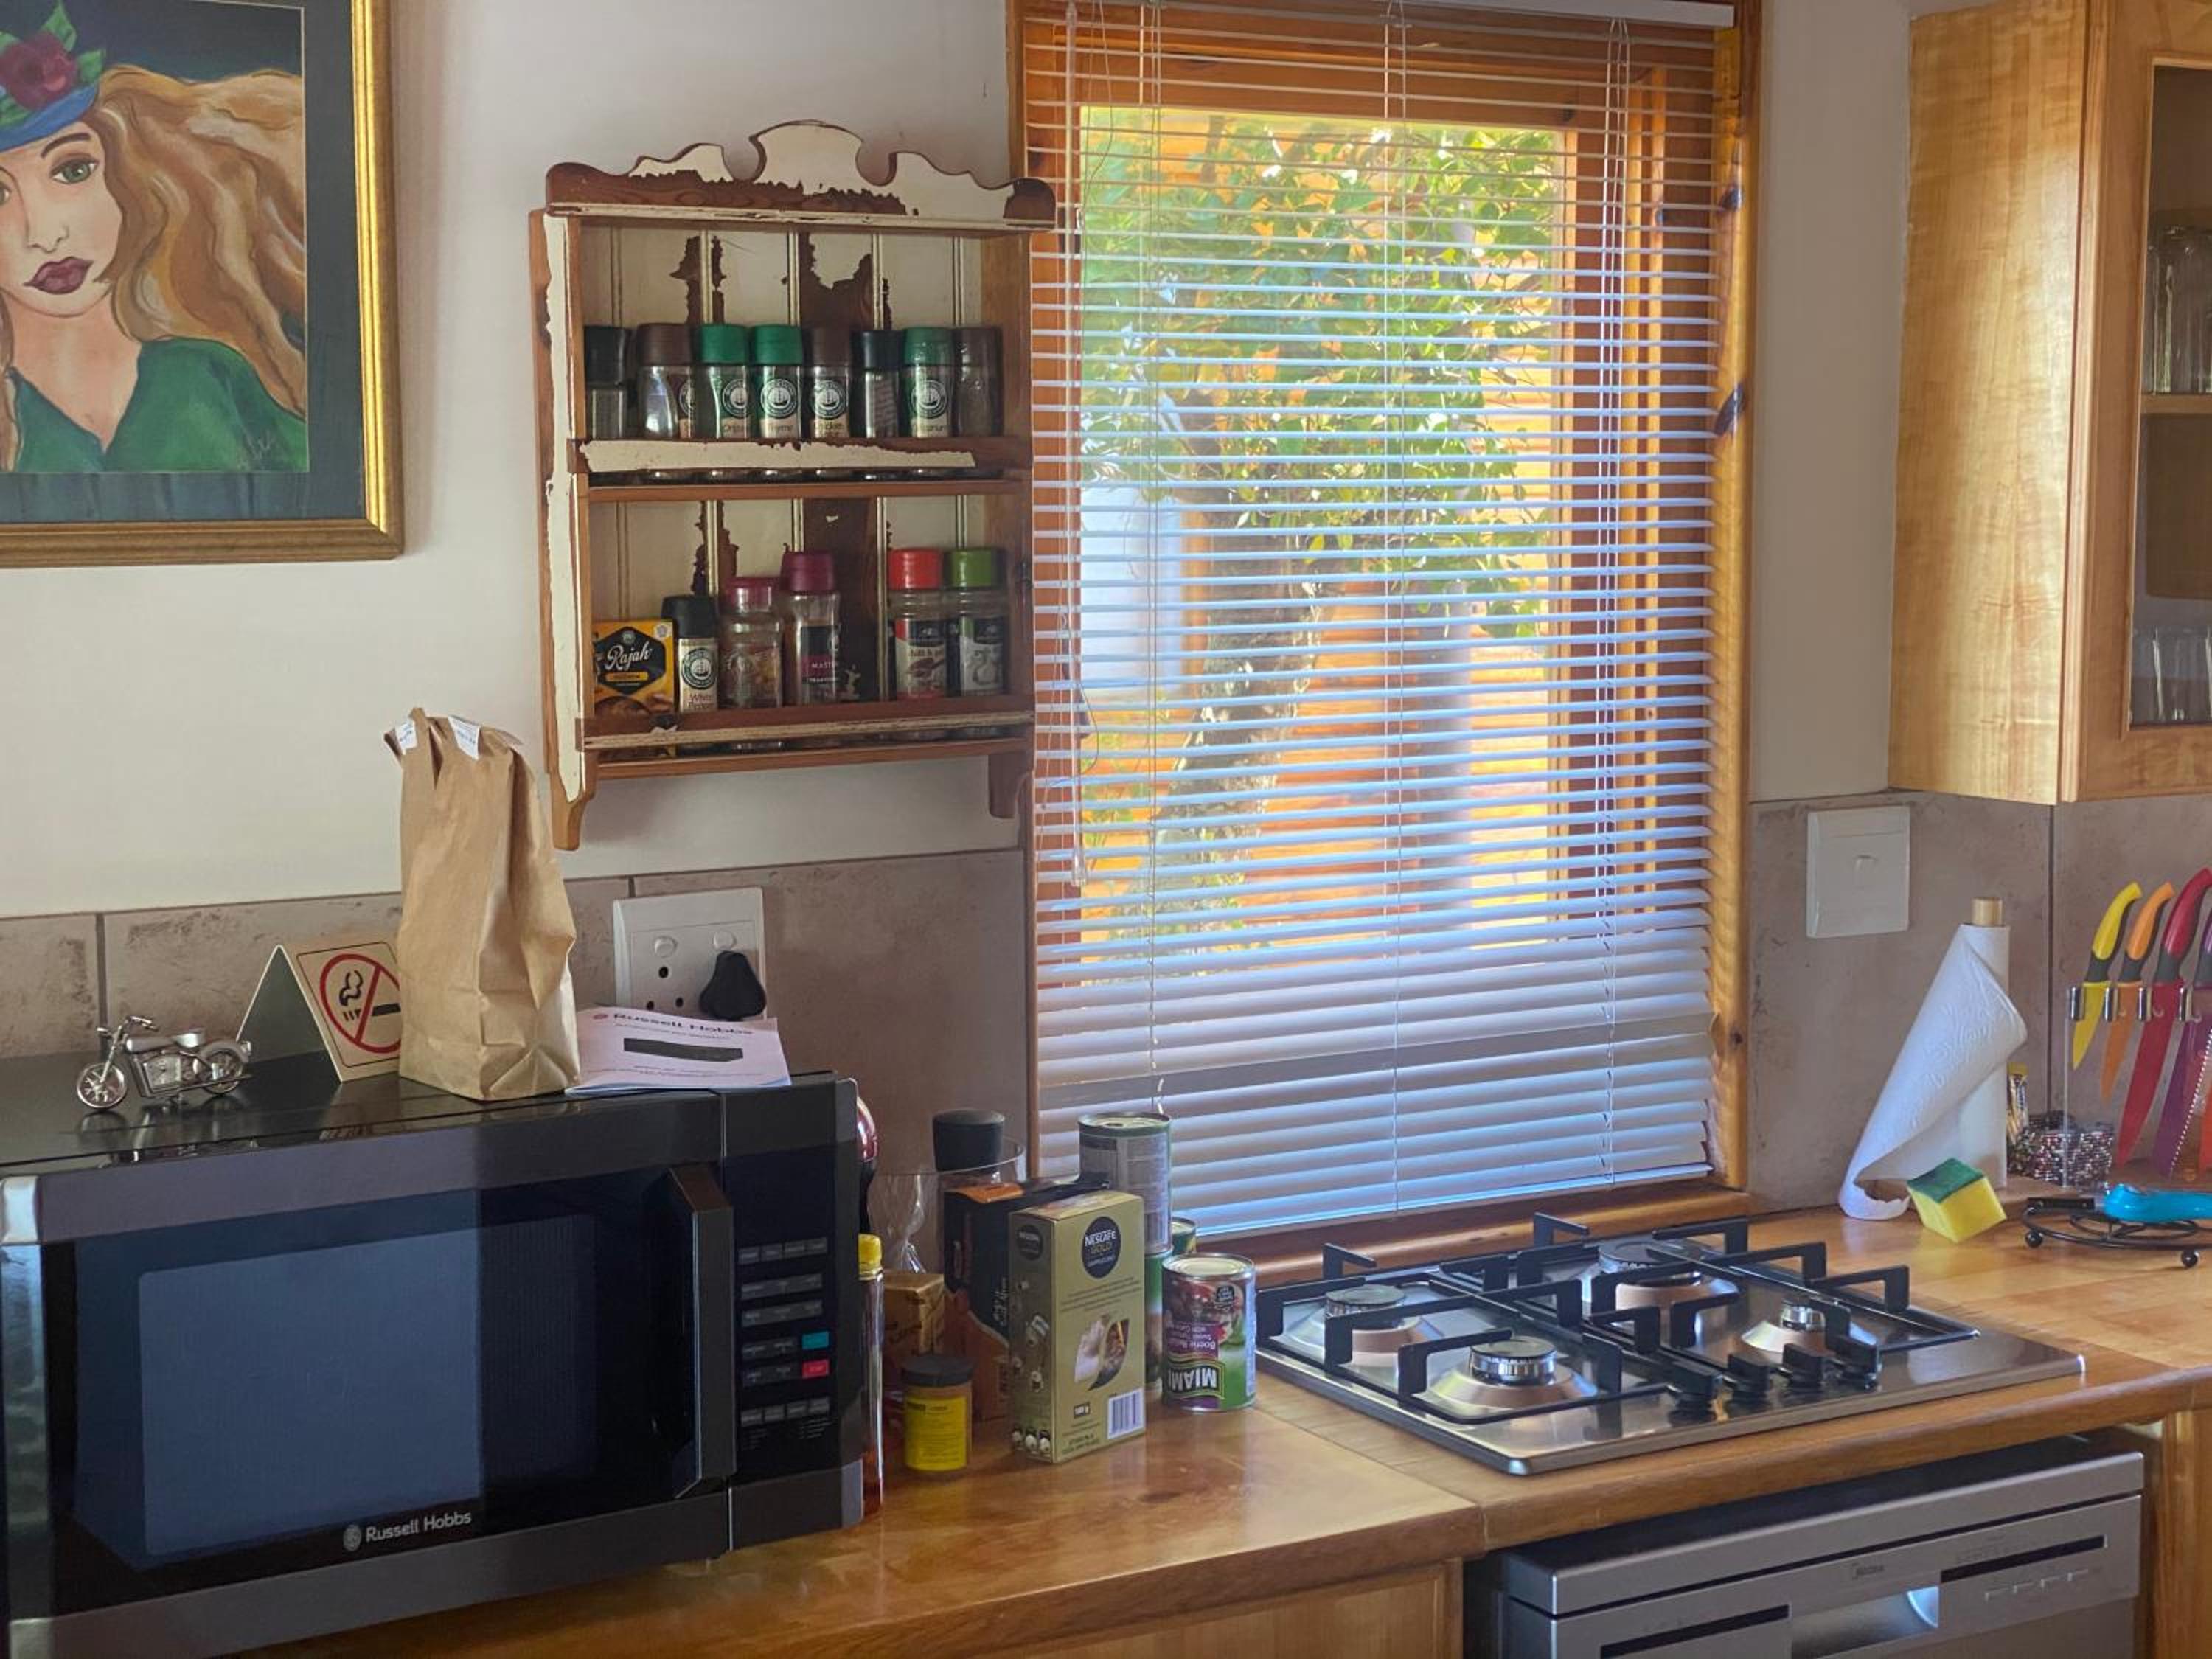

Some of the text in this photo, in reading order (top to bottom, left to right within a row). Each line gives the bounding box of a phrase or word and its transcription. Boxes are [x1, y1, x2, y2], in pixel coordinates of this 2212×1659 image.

[605, 641, 650, 671] Rajah
[613, 1013, 684, 1027] Russell
[690, 1023, 753, 1035] Hobbs
[1169, 1368, 1217, 1391] MIAMI
[366, 1512, 472, 1543] Russell Hobbs
